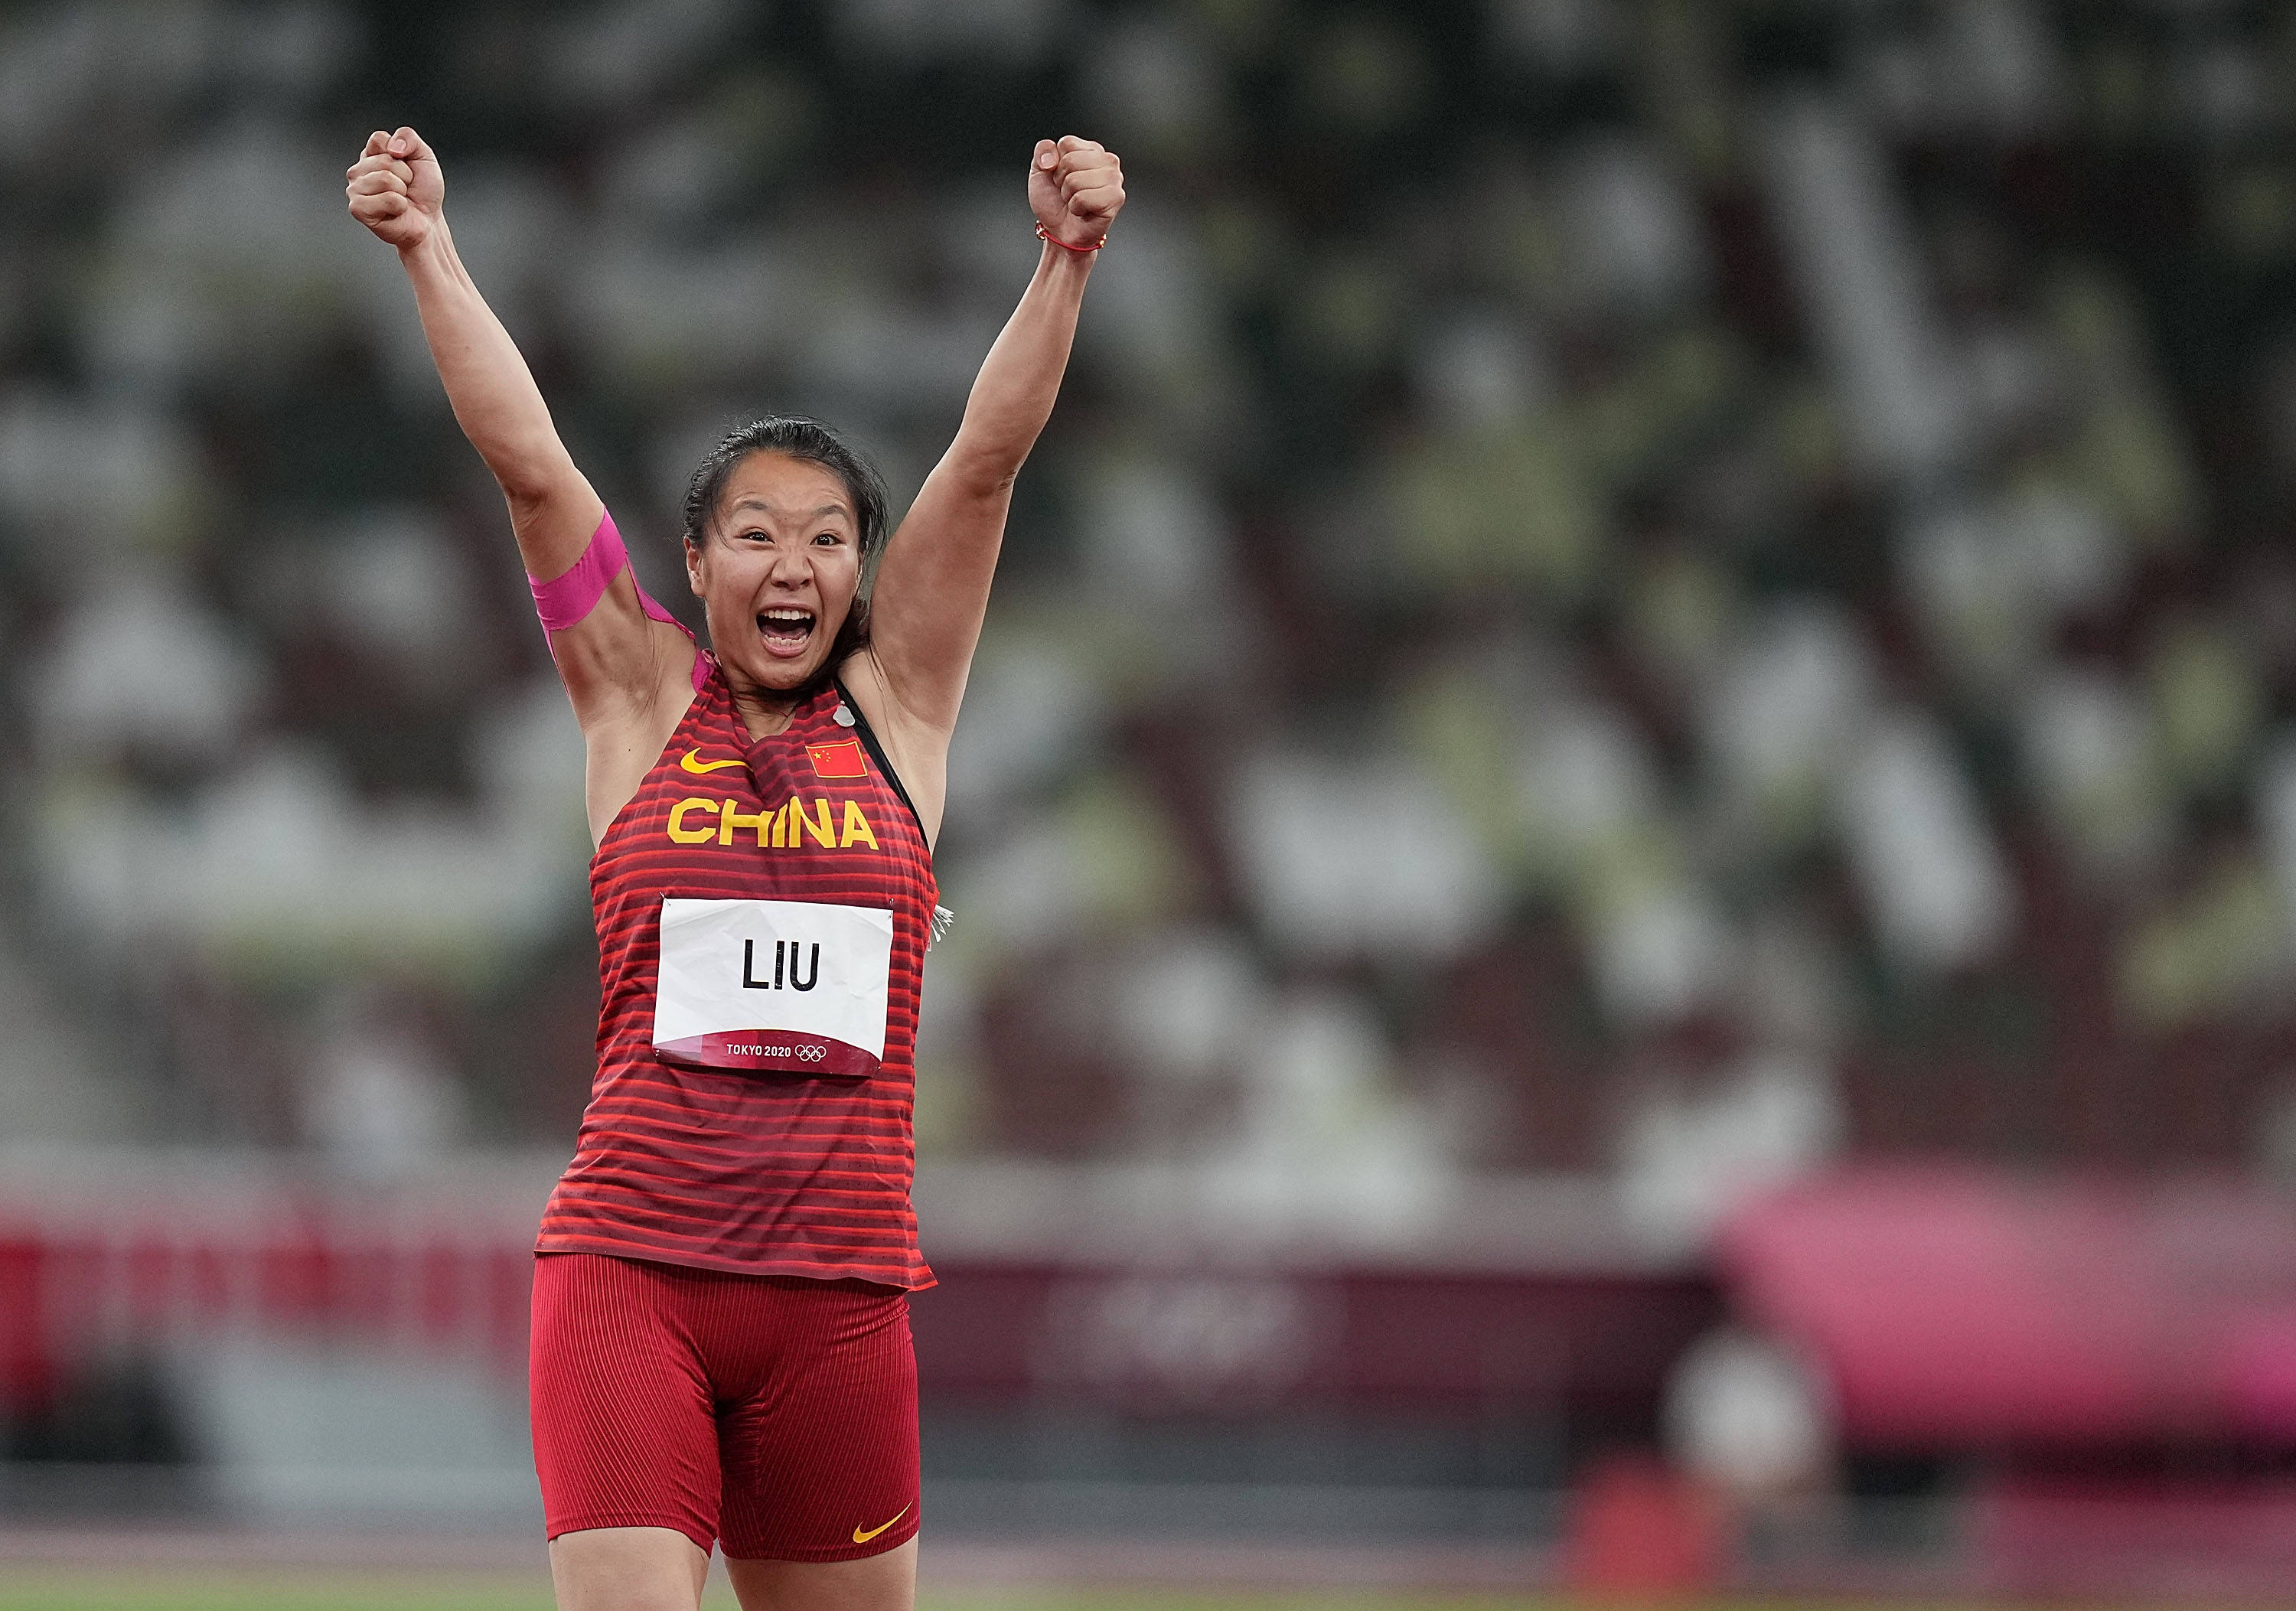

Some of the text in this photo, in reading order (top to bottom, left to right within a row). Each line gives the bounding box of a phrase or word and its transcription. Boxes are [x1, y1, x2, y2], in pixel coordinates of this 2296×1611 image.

[667, 795, 880, 850] CHINA
[742, 938, 820, 992] LIU
[726, 1044, 791, 1057] TOKYO 2020
